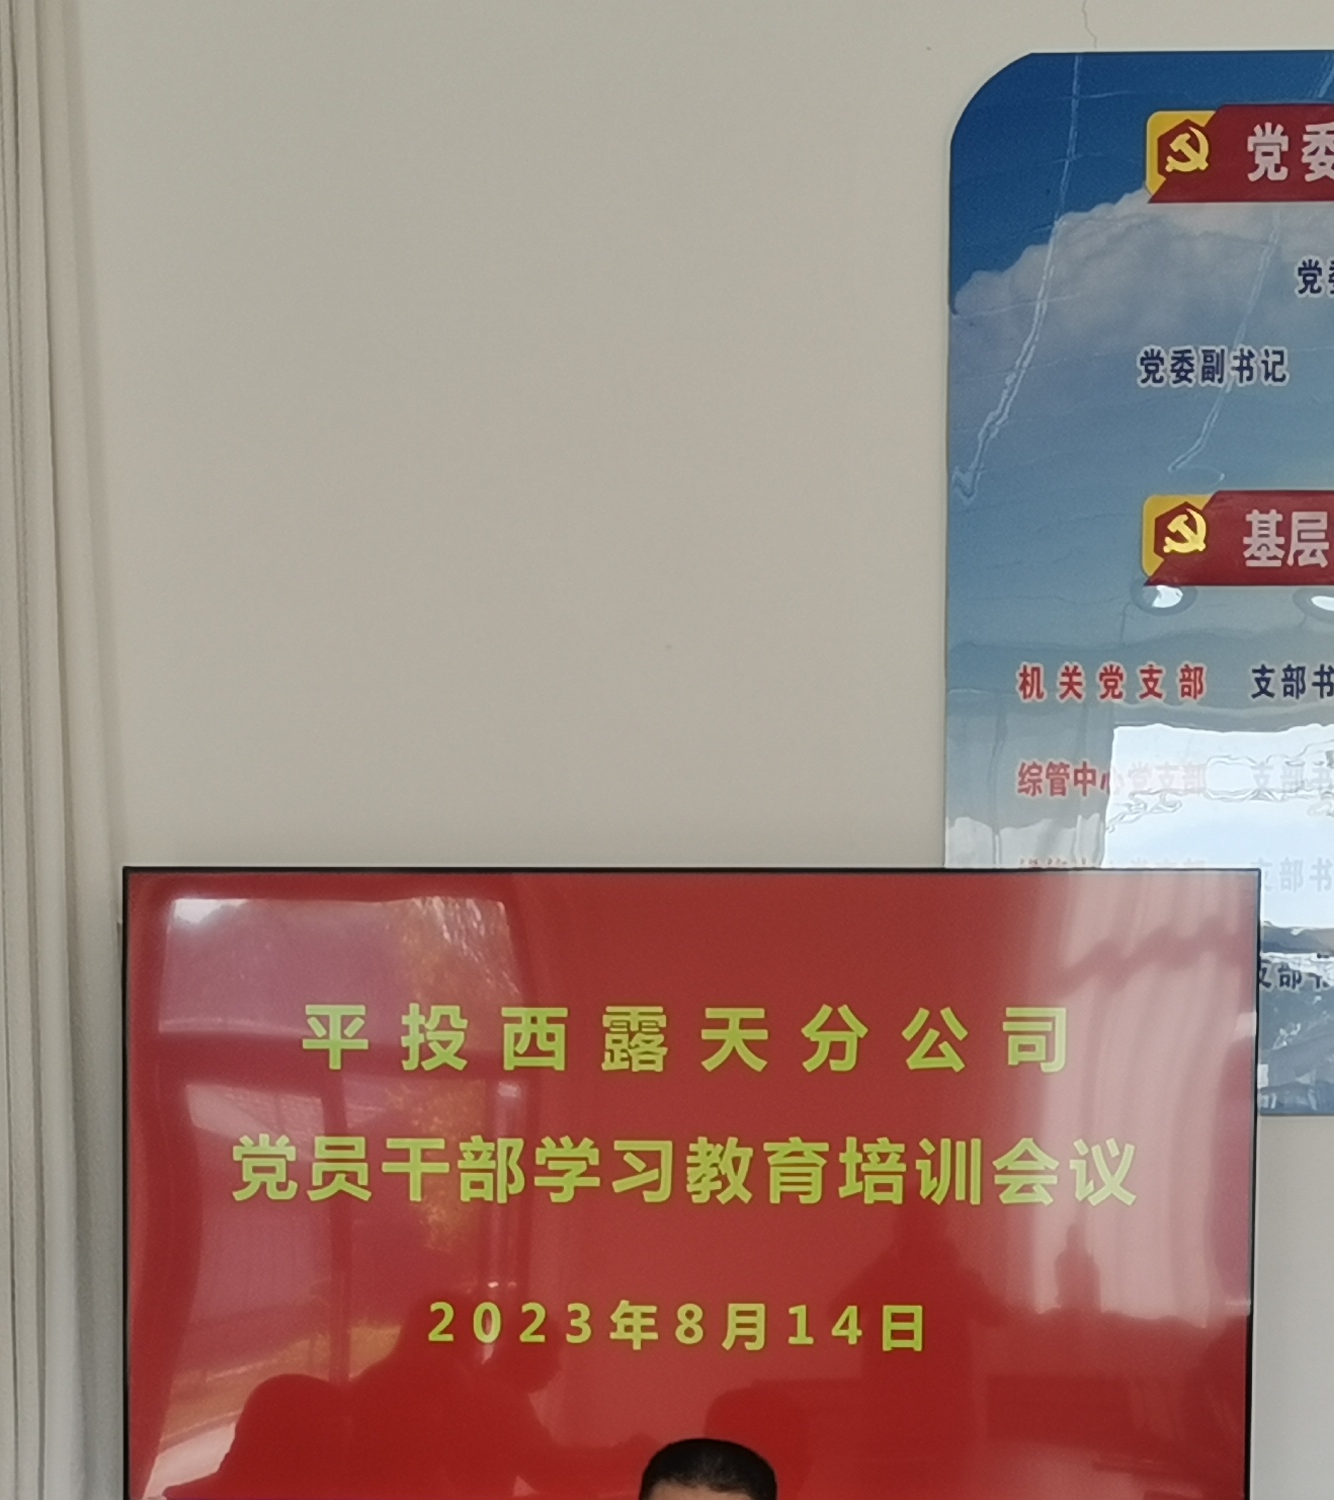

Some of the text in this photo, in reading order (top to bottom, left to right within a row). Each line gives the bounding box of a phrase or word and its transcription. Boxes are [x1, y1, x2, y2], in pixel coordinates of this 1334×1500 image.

[1139, 348, 1288, 386] 党委副书记
[1019, 663, 1208, 702] 机关党支部
[301, 1002, 1070, 1074] 平投西露天分公司
[232, 1134, 1138, 1207] 党员干部学习教育培训会议
[428, 1301, 926, 1353] 2023年8月14日
